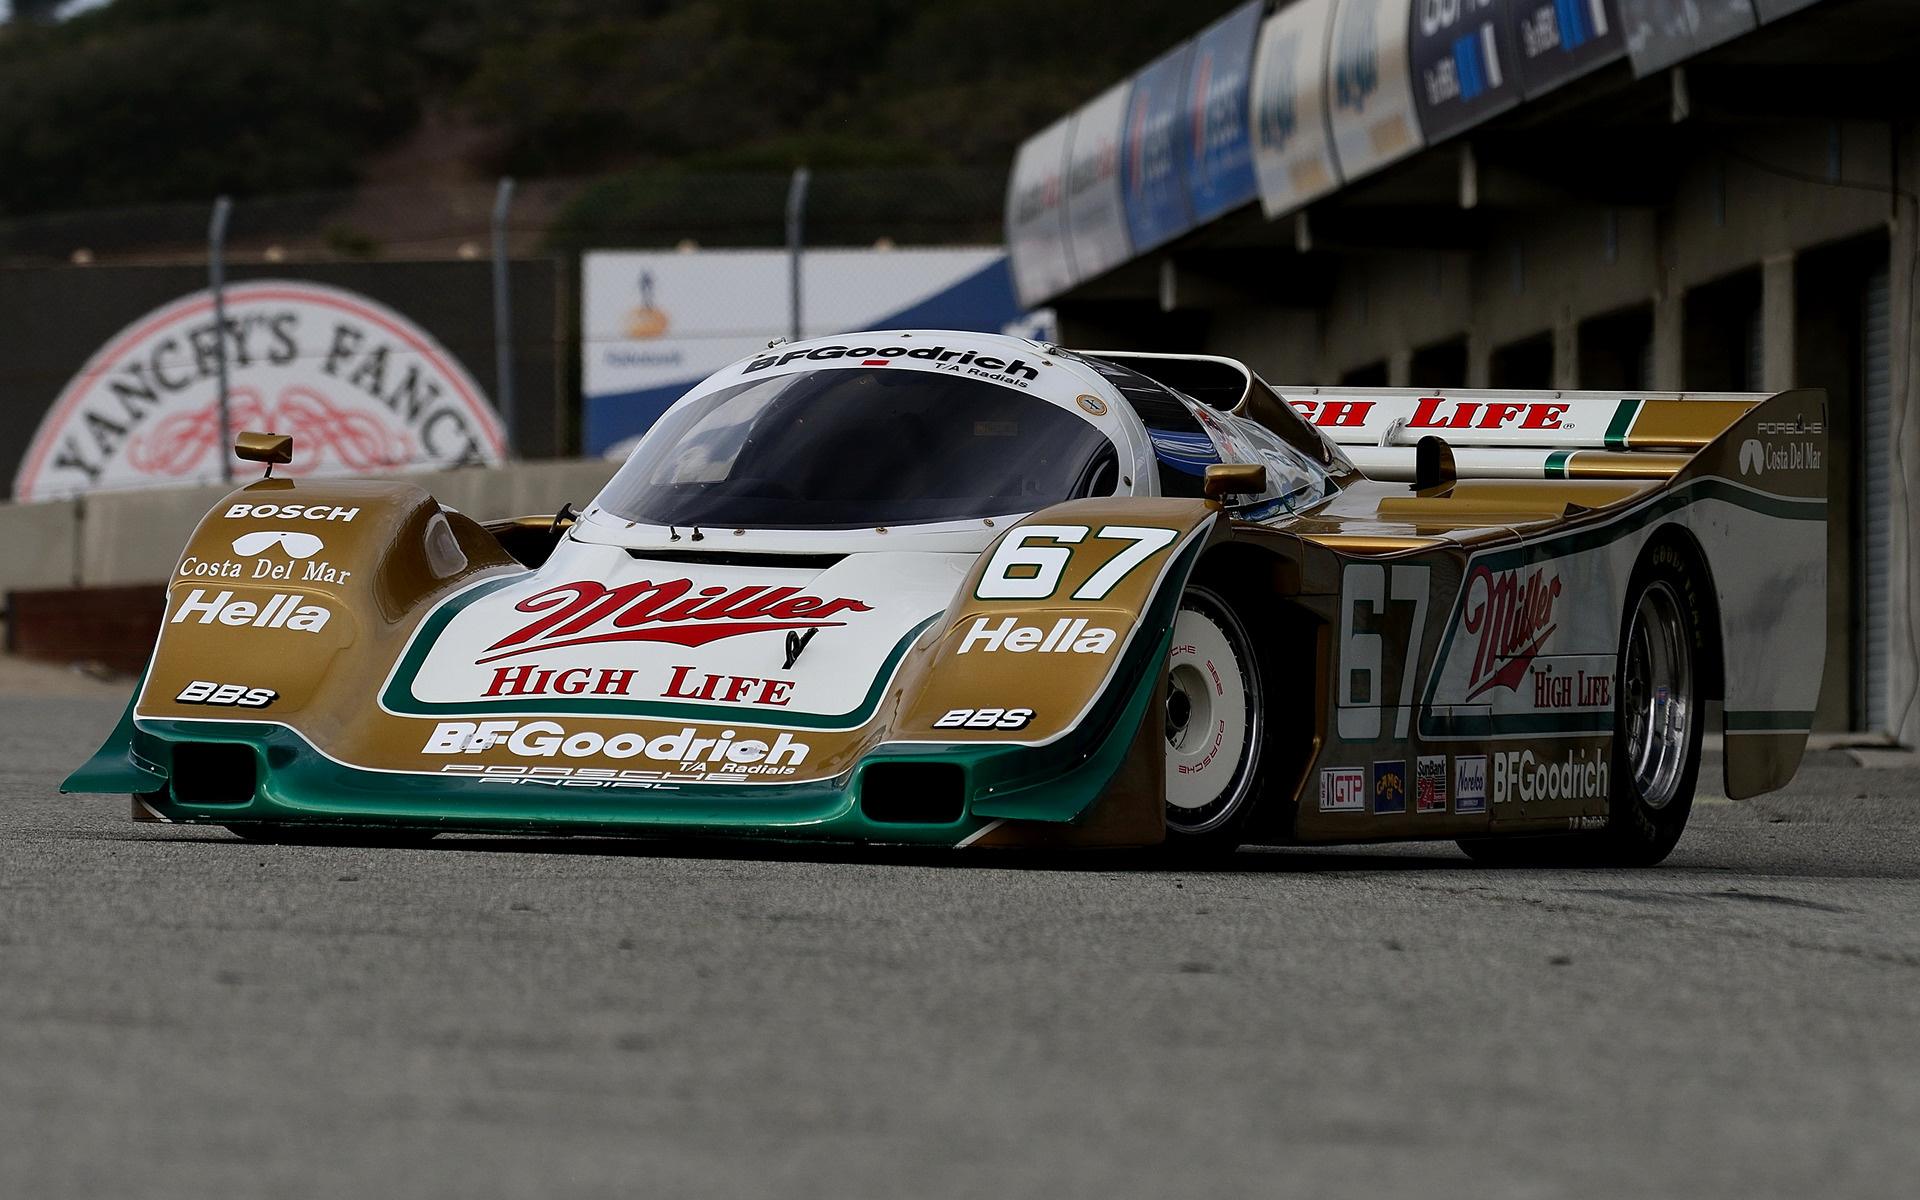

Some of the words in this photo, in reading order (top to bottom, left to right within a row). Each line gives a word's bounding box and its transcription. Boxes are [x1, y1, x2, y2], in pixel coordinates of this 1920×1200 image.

[741, 346, 1039, 381] BFGoodrich
[935, 363, 961, 373] T/A
[967, 367, 1029, 388] Radials
[53, 311, 299, 481] YANCEY'S
[1404, 397, 1571, 429] LIFE
[1758, 422, 1822, 435] PORSCHE
[1766, 442, 1788, 470] Costa
[1790, 442, 1804, 470] Del
[1806, 442, 1821, 470] Mar
[224, 504, 360, 522] BOSCH
[179, 557, 242, 578] Costa
[252, 559, 295, 580] Del
[301, 561, 351, 585] Mar
[974, 525, 1181, 601] 67
[170, 589, 331, 634] Hella
[480, 577, 876, 654] Miller
[1463, 564, 1562, 692] Miller
[957, 617, 1118, 655] Hella
[1168, 645, 1197, 657] CHE
[1337, 563, 1431, 739] 67
[176, 680, 280, 709] BBS
[480, 664, 638, 697] HIGH
[660, 665, 796, 706] LIFE
[1534, 671, 1572, 708] HIGH
[1577, 670, 1611, 707] LIFE
[932, 708, 1037, 731] BBS
[421, 720, 810, 766] BFGoodrich
[1178, 719, 1225, 775] PORSCHE
[440, 764, 749, 782] PORSCHE
[478, 778, 681, 790] ANDIAL
[680, 761, 708, 773] T/A
[720, 763, 797, 776] Radials
[1376, 771, 1404, 796] CAMEL
[1457, 761, 1484, 797] Norelco
[1493, 749, 1609, 804] BFGoodrich
[1335, 775, 1362, 803] GTP
